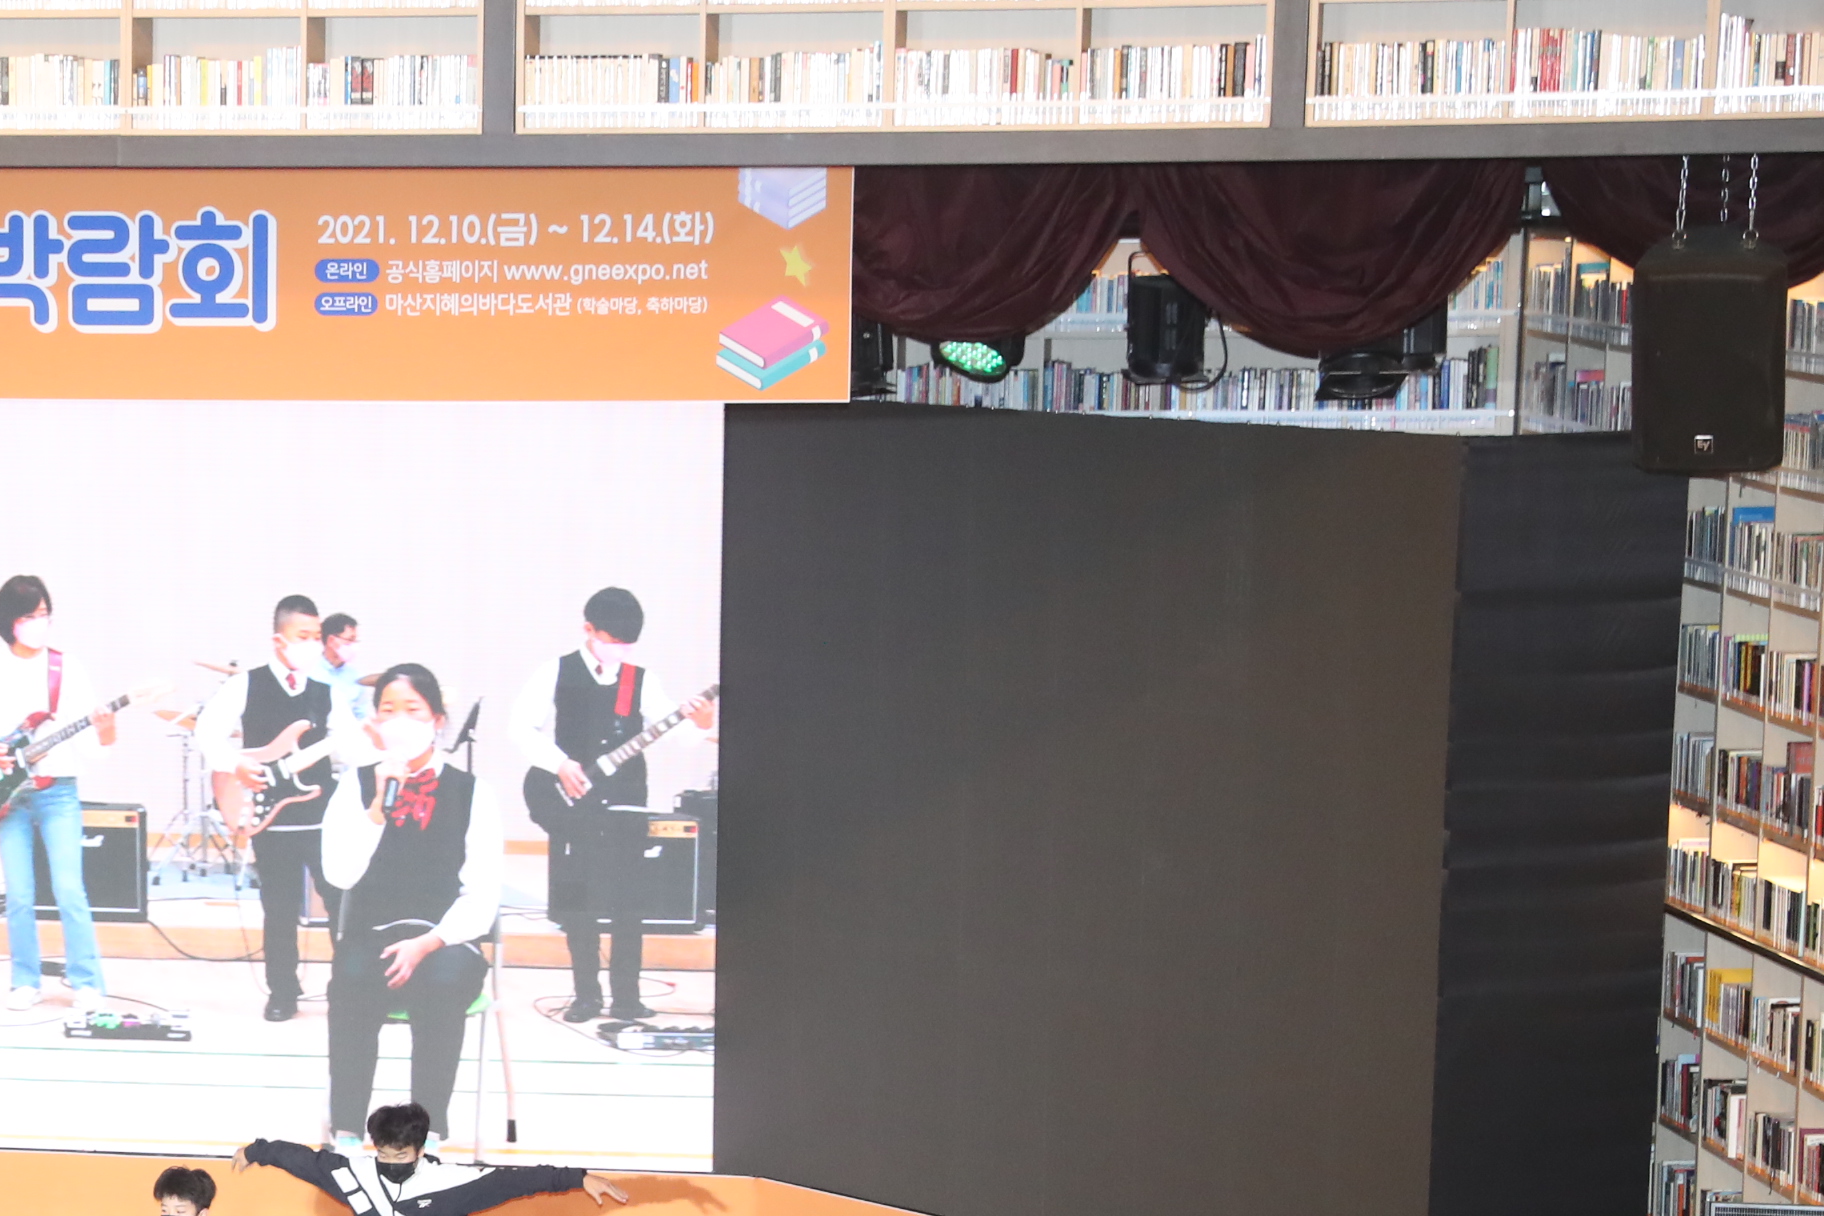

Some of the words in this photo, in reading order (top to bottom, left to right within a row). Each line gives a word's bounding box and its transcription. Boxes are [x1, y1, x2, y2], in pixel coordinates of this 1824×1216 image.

[317, 214, 397, 245] 2021.
[408, 212, 538, 247] 12.10.(금)
[580, 211, 715, 246] 12.14.(화)
[325, 261, 368, 280] 온라인
[385, 260, 498, 283] 공식홈페이지
[504, 259, 708, 284] www.gneexpo.net
[320, 295, 373, 313] 오프라인
[385, 293, 572, 316] 마산지혜의바다도서관
